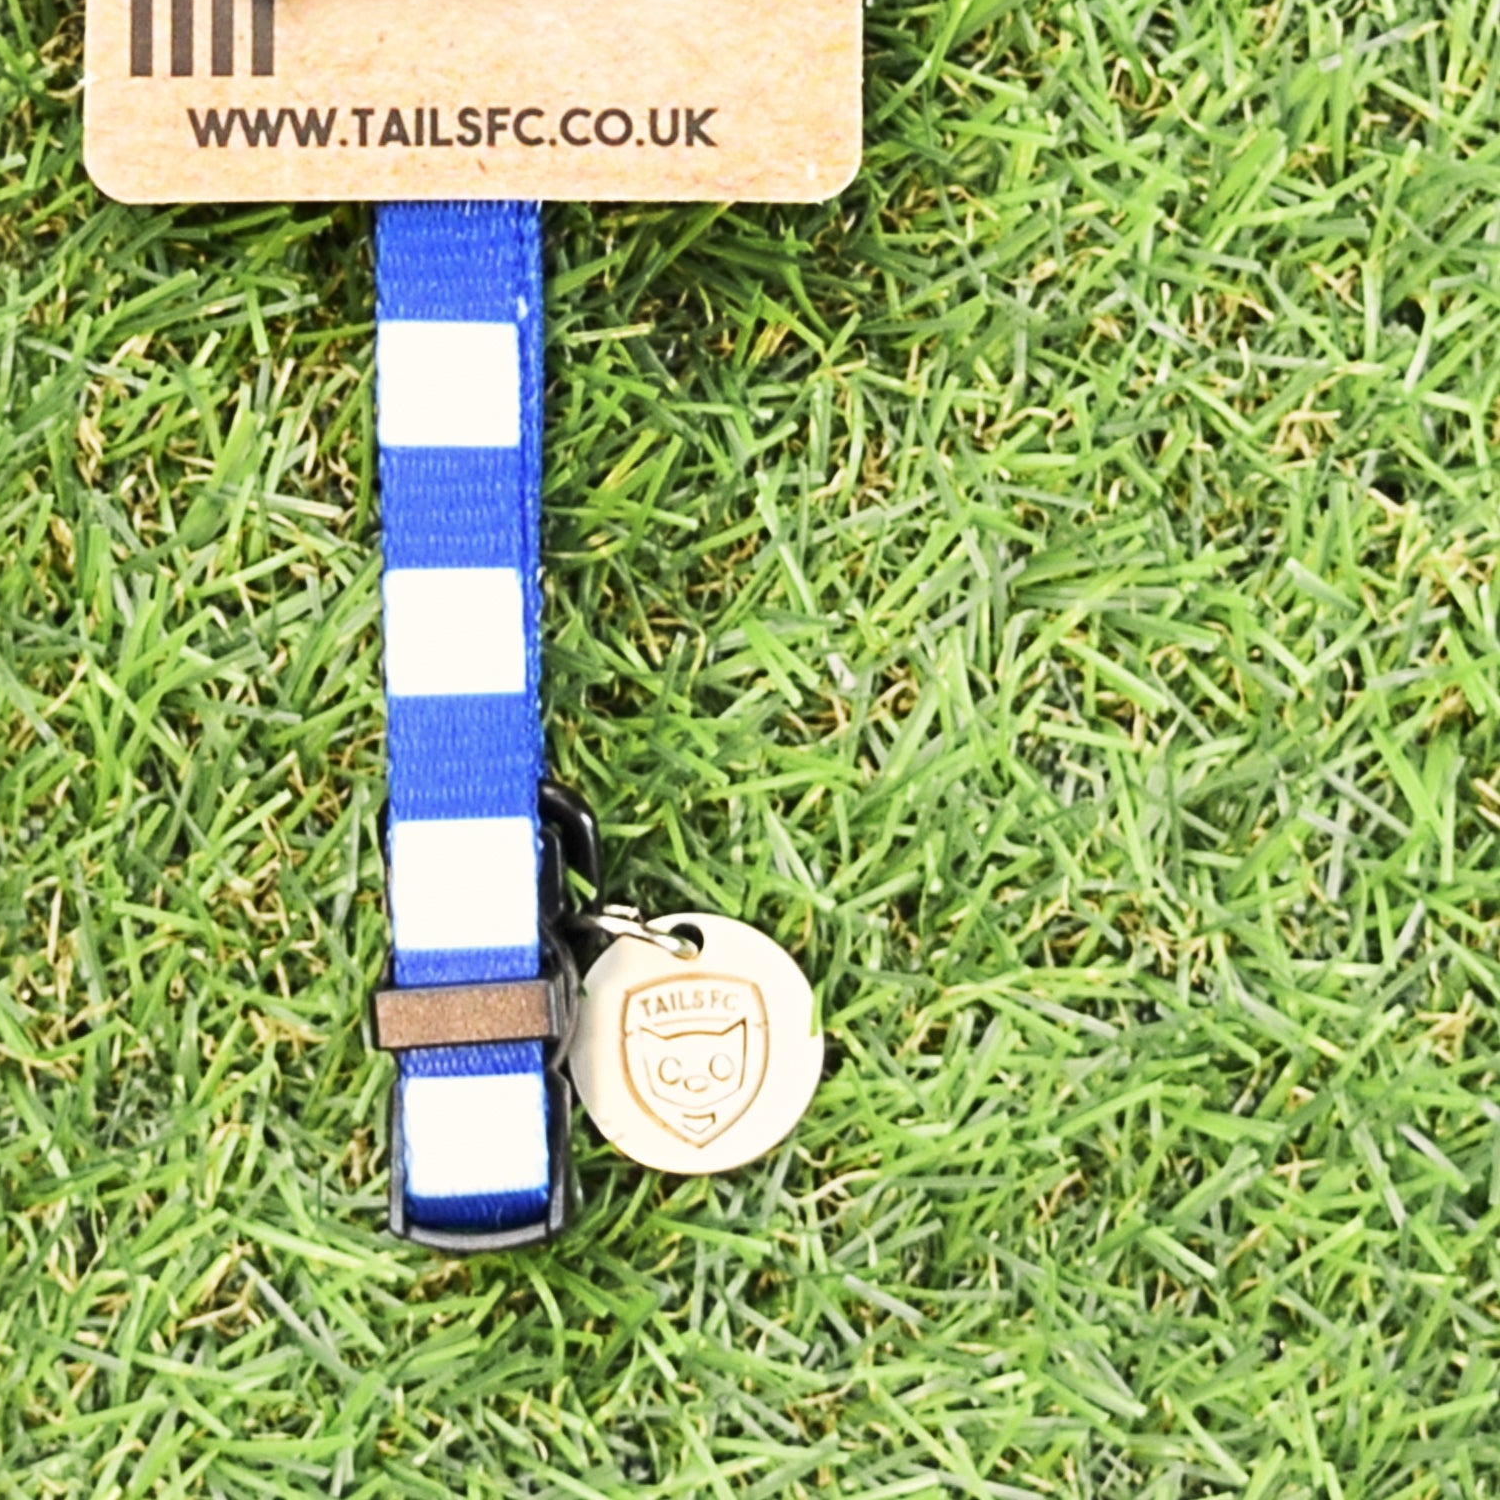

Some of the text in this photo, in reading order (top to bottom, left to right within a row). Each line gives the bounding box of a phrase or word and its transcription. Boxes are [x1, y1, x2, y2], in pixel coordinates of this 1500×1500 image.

[188, 107, 718, 148] WWW.TAILSFC.CO.UK
[639, 990, 739, 1017] TAILS FC
